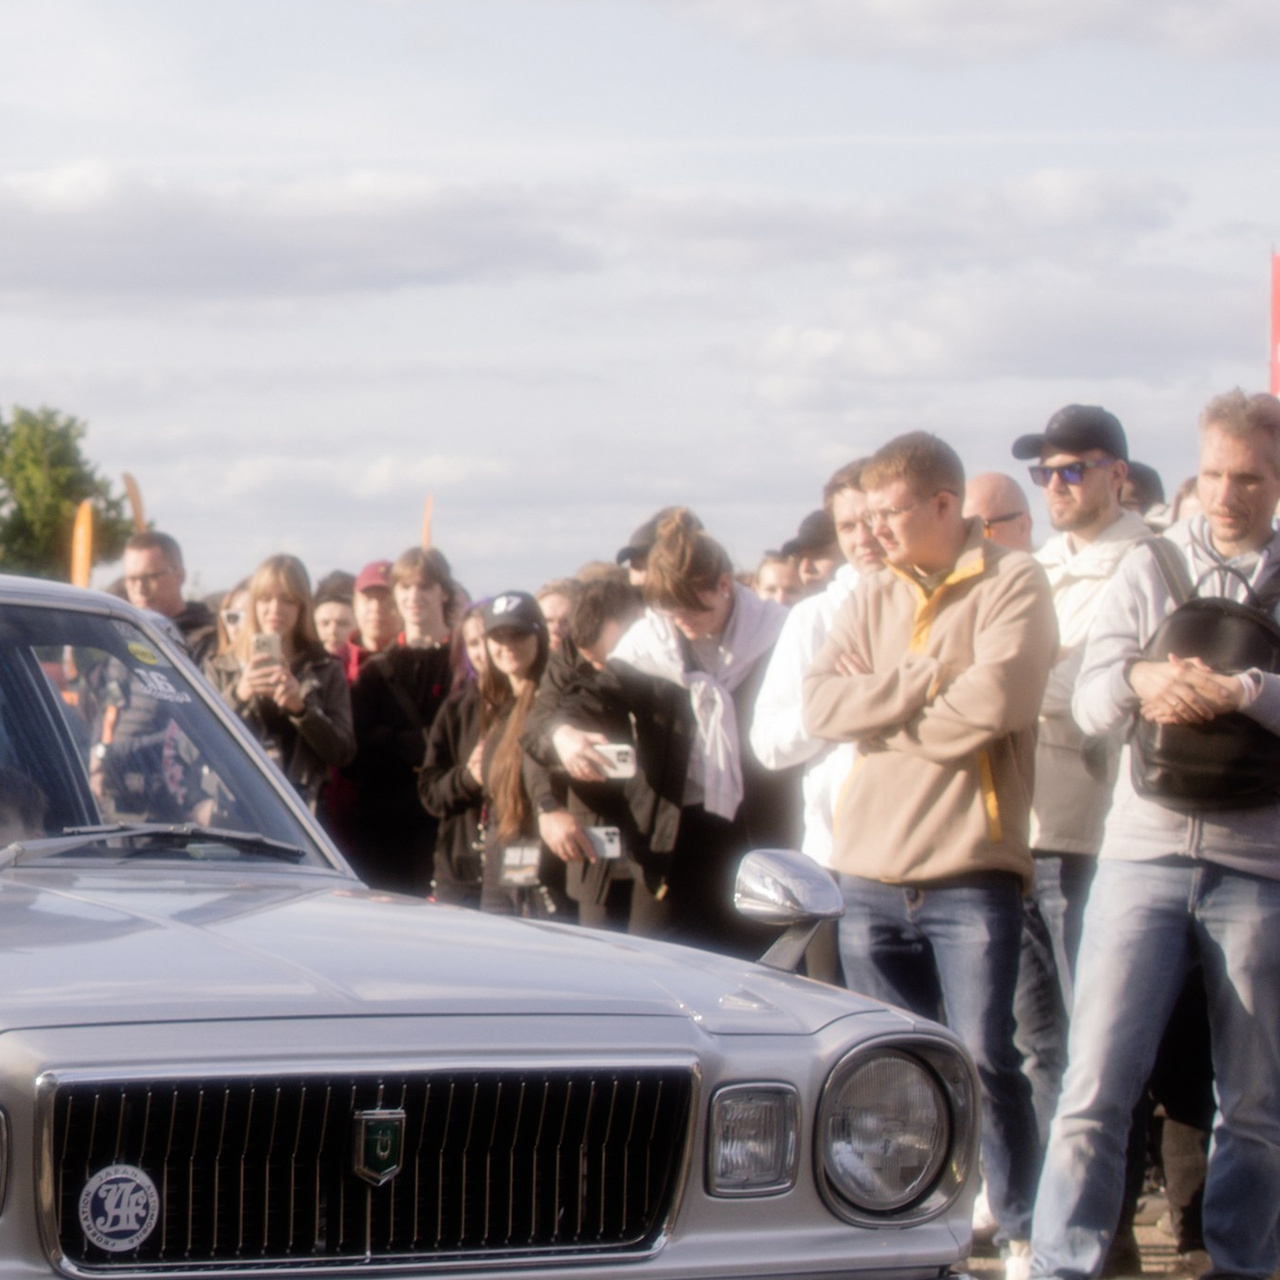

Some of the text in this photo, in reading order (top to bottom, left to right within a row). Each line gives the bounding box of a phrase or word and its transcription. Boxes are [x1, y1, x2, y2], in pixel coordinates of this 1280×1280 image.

[99, 1168, 137, 1182] JAPAN
[81, 1190, 116, 1247] FEDERATION
[128, 1185, 157, 1244] AUTOMOBILE
